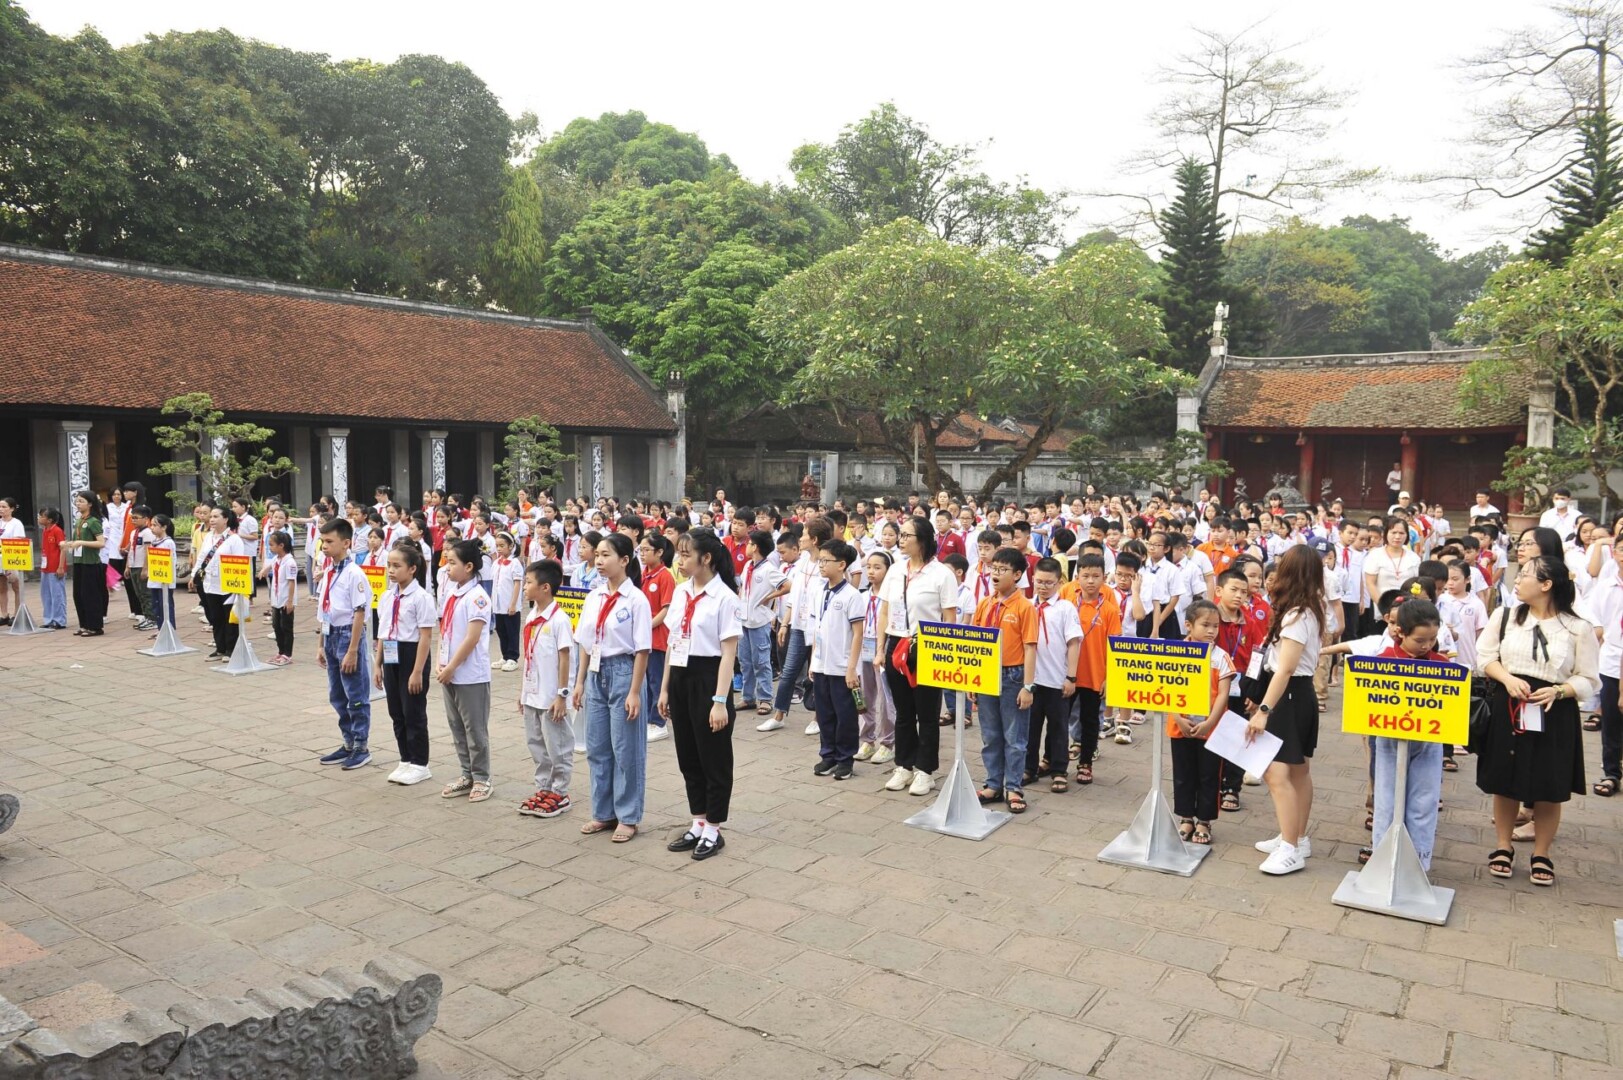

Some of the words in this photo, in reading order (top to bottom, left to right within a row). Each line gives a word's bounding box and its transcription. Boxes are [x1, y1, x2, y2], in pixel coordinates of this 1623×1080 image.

[374, 594, 378, 602] 2
[939, 627, 951, 636] VỰC
[924, 640, 953, 651] TRẠNG
[1133, 643, 1148, 652] VỰC
[1150, 644, 1164, 652] THÍ
[1166, 645, 1186, 654] SINH
[933, 653, 954, 663] NHỎ
[1115, 658, 1152, 670] TRẠNG
[1354, 661, 1374, 670] KHU
[1377, 662, 1396, 673] VỰC
[1398, 664, 1414, 673] THÍ
[1417, 666, 1441, 676] SINH
[1444, 668, 1461, 677] THI
[933, 667, 968, 685] KHỐI
[972, 675, 981, 687] 4
[1127, 671, 1153, 682] NHỎ
[1355, 678, 1400, 691] TRẠNG
[1127, 686, 1170, 706] KHỐI
[1176, 694, 1187, 707] 3
[1368, 692, 1400, 705] NHỎ
[1369, 710, 1421, 732] KHỐI
[1429, 720, 1440, 734] 2
